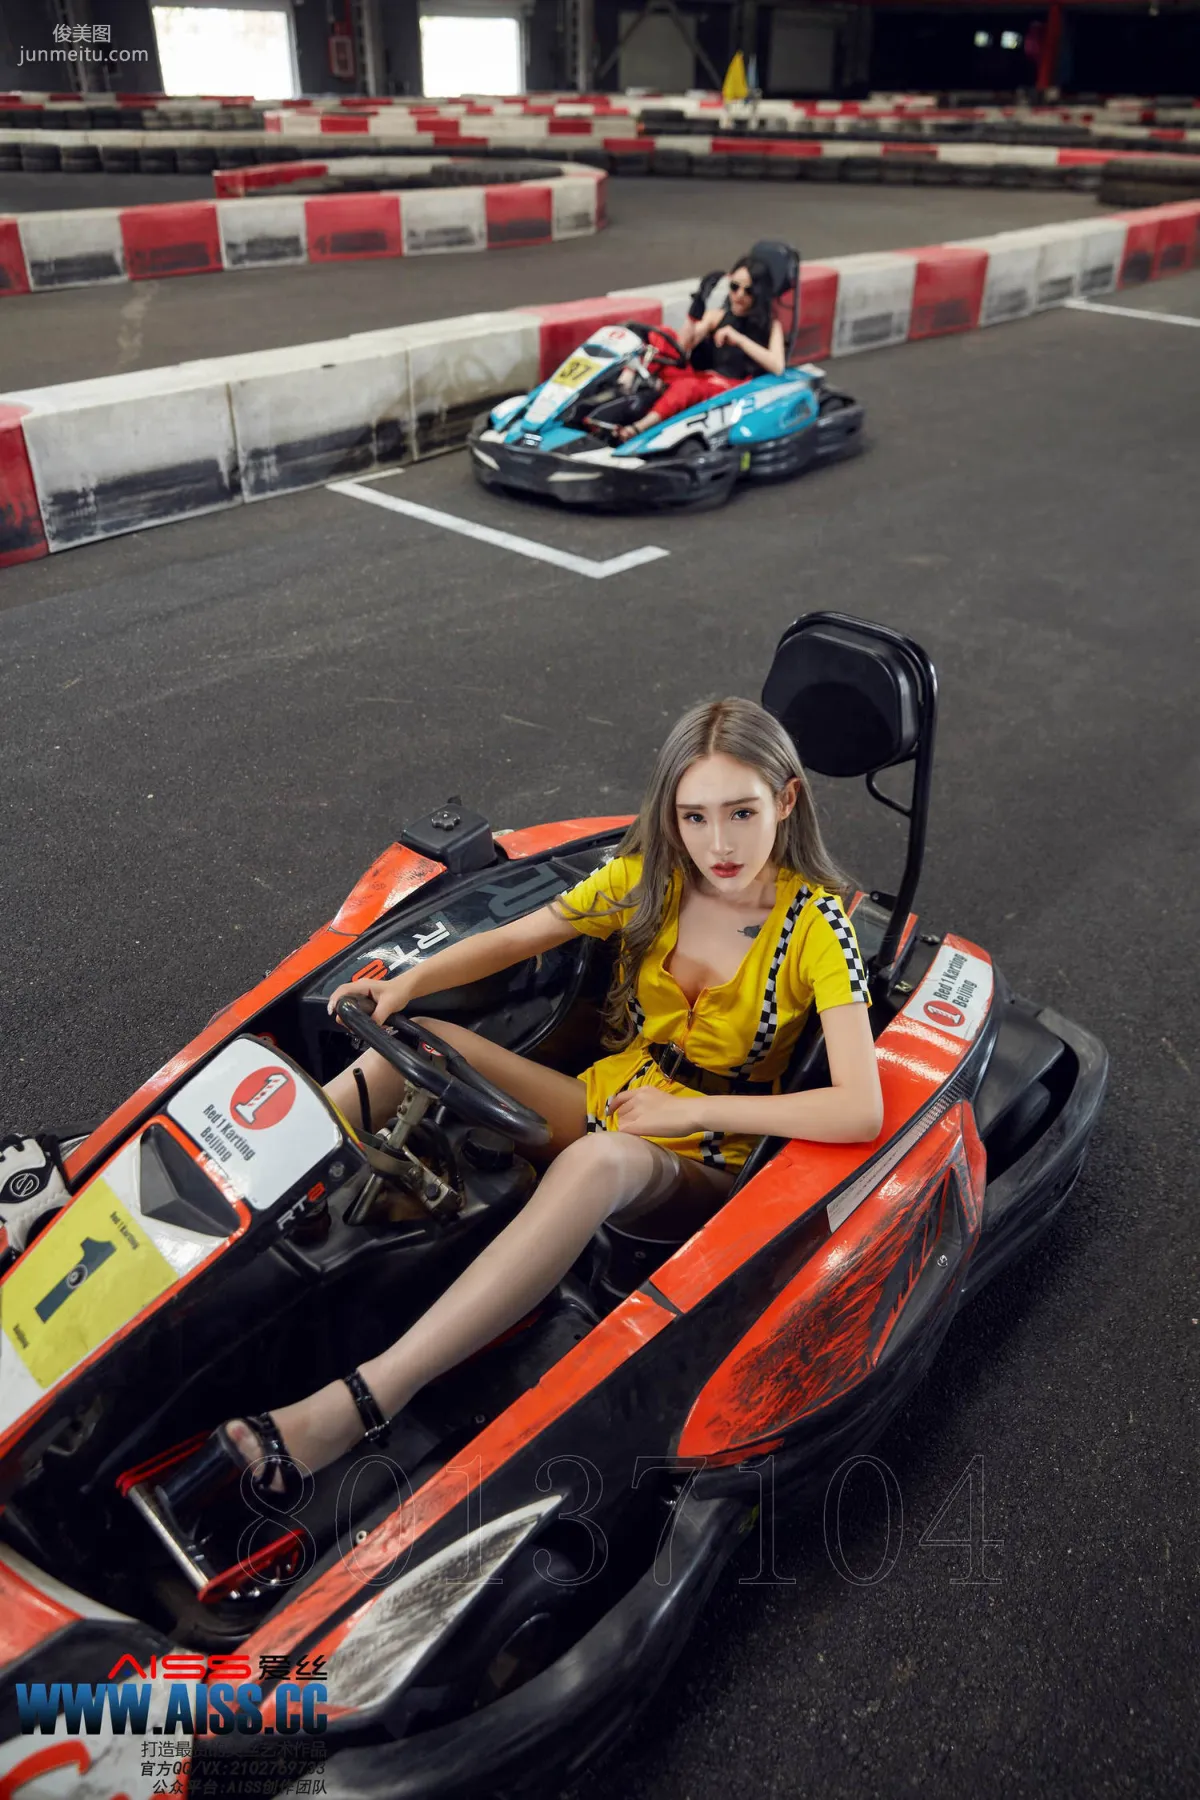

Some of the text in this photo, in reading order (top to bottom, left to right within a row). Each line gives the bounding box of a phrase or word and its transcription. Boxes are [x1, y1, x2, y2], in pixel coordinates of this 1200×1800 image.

[560, 362, 594, 381] 37
[942, 953, 968, 981] Karting
[933, 981, 952, 1000] Red
[952, 979, 977, 1008] Beijing
[234, 1072, 290, 1125] 1
[200, 1126, 233, 1163] Beijing
[202, 1104, 221, 1123] Red
[222, 1121, 256, 1161] Karting
[276, 1181, 327, 1230] RT8
[34, 1237, 117, 1324] 1
